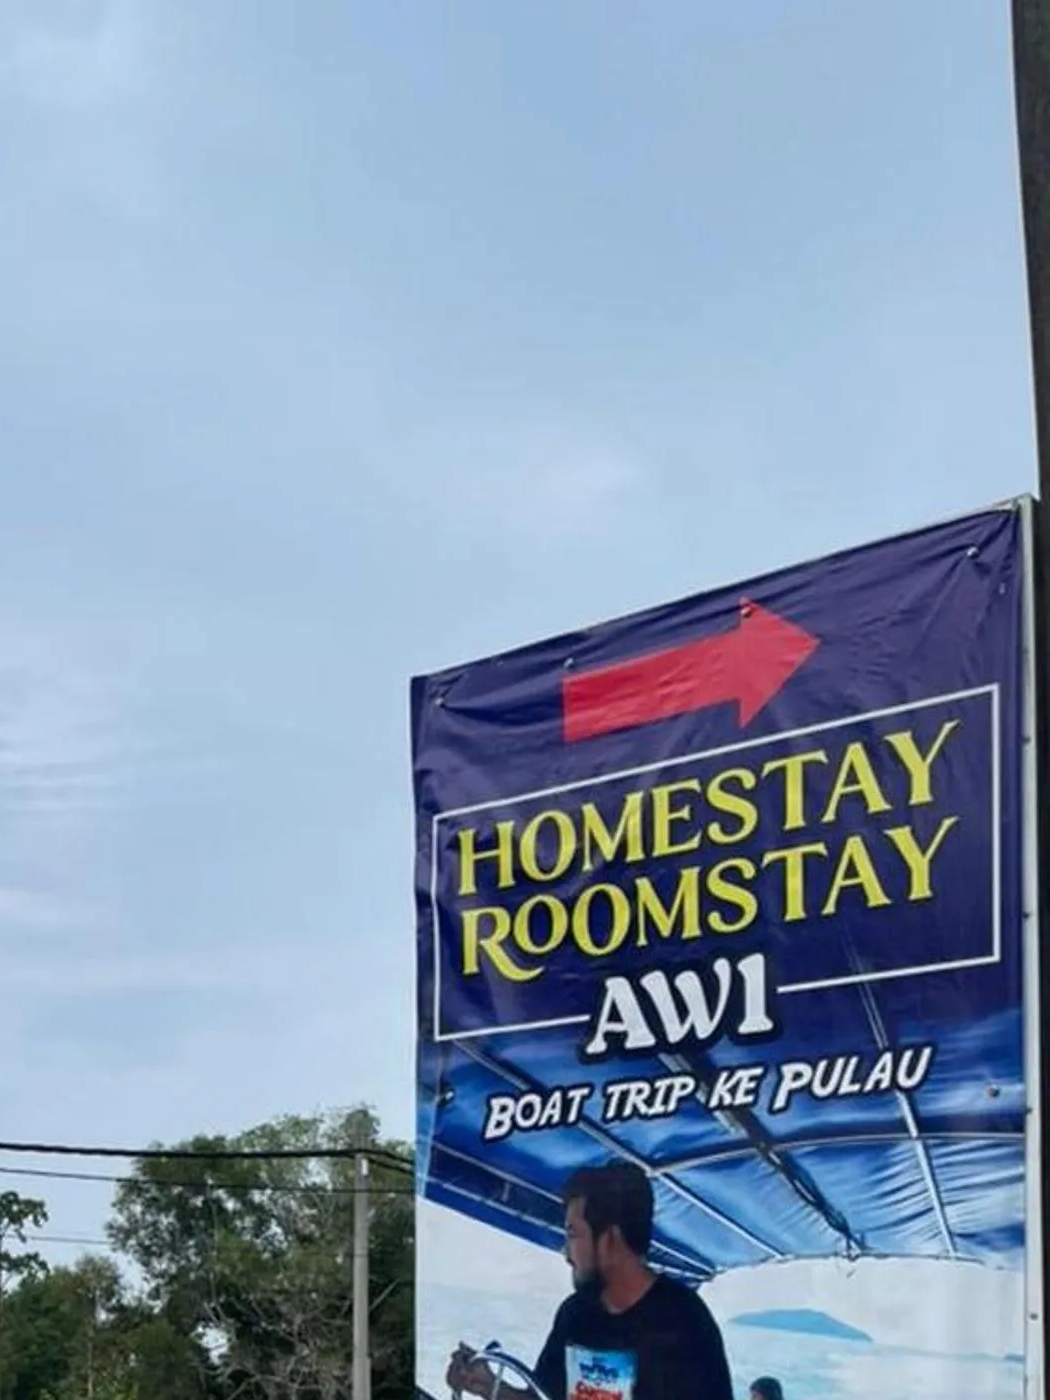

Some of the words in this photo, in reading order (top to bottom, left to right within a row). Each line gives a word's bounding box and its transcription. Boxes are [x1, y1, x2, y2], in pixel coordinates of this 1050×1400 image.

[458, 720, 960, 896] HOMESTAY
[461, 816, 960, 981] ROOMSTAY
[586, 953, 773, 1054] AWI
[484, 1087, 588, 1139] BOAT
[606, 1077, 697, 1119] TRIP
[709, 1067, 764, 1111] KE
[769, 1047, 933, 1112] PULAU
